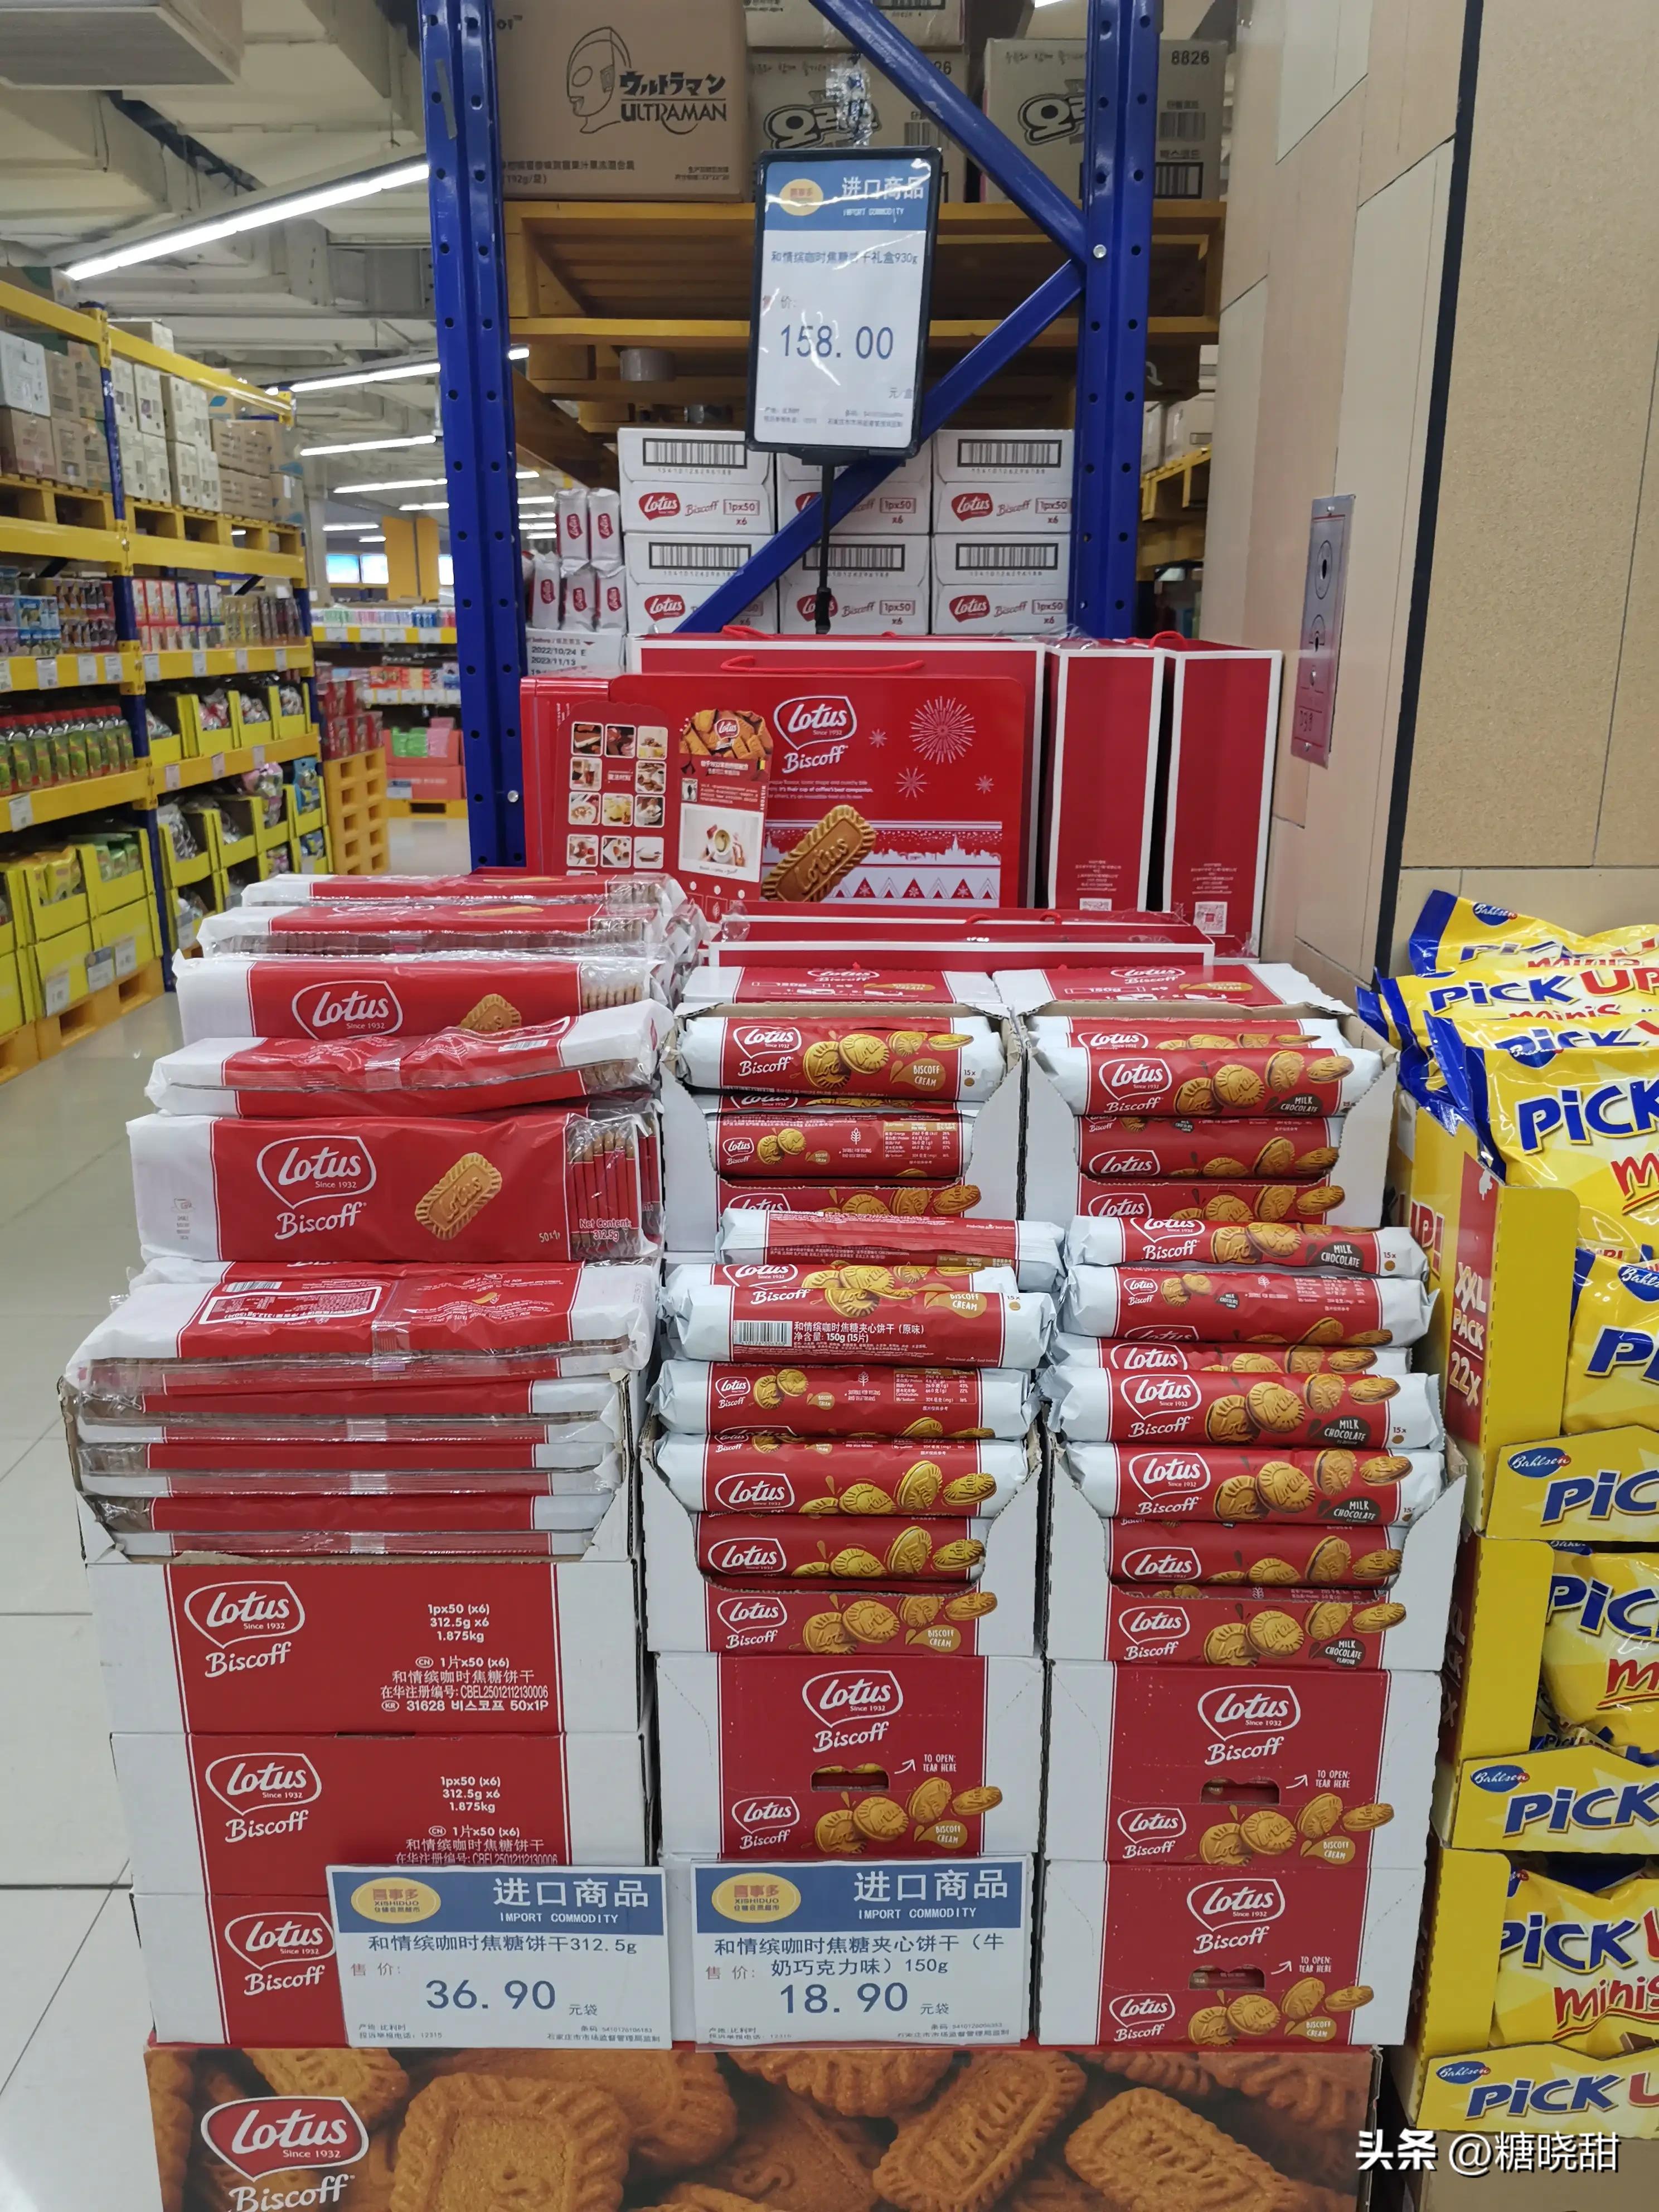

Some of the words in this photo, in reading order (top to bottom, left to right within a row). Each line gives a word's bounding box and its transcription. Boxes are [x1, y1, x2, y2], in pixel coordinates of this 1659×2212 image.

[1171, 50, 1209, 65] 8826
[620, 71, 726, 97] ウルトラマン
[620, 102, 726, 123] ULTRAMAN
[842, 176, 924, 200] 进口商品
[728, 503, 756, 512] 1px50
[884, 501, 912, 511] 1px50
[1040, 501, 1068, 511] 1px50
[884, 603, 911, 612] 1px50
[1036, 601, 1063, 612] 1px50
[788, 704, 847, 733] Lotus
[782, 745, 848, 774] Biscoff
[312, 993, 391, 1029] Lotus
[738, 1056, 794, 1076] Biscoff
[913, 1065, 940, 1075] BISCOFF
[914, 1076, 937, 1087] CREAM
[1111, 1064, 1163, 1086] Lotus
[1280, 1102, 1318, 1114] CHOCOLATE
[1294, 1096, 1313, 1105] MILK
[278, 1146, 362, 1186] Lotus
[1102, 1156, 1153, 1173] Lotus
[274, 1202, 367, 1240] Biscoff
[579, 1219, 595, 1229] Net
[593, 1229, 619, 1242] 312.5g
[1333, 1244, 1352, 1254] MILK
[1321, 1252, 1360, 1267] CHOCOLATE
[1454, 1262, 1487, 1312] XXL
[750, 1287, 812, 1304] Biscoff
[952, 1300, 977, 1311] CREAM
[794, 1322, 924, 1335] 和情缤咖时焦糖夹心饼干（原味）
[1452, 1308, 1485, 1351] PACK
[826, 1333, 845, 1343] 150g
[847, 1333, 869, 1343] (15片)
[1135, 1379, 1192, 1403] Lotus
[1128, 1416, 1194, 1438] Biscoff
[1339, 1419, 1359, 1430] MILK
[1324, 1428, 1366, 1442] CHOCOLATE
[1511, 1454, 1570, 1469] Bahlsen
[1143, 1457, 1201, 1483] Lotus
[729, 1481, 785, 1505] Lotus
[1135, 1495, 1202, 1516] Biscoff
[1348, 1501, 1370, 1511] MILK
[1333, 1508, 1376, 1521] CHOCOLATE
[722, 1545, 777, 1566] Lotus
[1134, 1553, 1192, 1577] Lotus
[207, 1592, 290, 1627] Lotus
[428, 1604, 464, 1617] 1px50
[467, 1603, 490, 1616] (x6)
[729, 1603, 779, 1622] Lotus
[266, 1622, 285, 1630] 1932
[430, 1617, 473, 1629] 312.5g
[474, 1617, 489, 1628] x6
[1131, 1613, 1182, 1634] Lotus
[437, 1631, 484, 1643] 1.875kg
[726, 1629, 778, 1649] Biscoff
[928, 1629, 954, 1638] BISCOFF
[929, 1638, 952, 1648] CREAM
[1338, 1640, 1356, 1650] MILK
[1126, 1641, 1178, 1661] Biscoff
[1325, 1647, 1362, 1660] CHOCOLATE
[205, 1641, 292, 1677] Biscoff
[487, 1656, 510, 1668] (x6)
[392, 1670, 535, 1684] 和情缤咖时焦糖饼干
[820, 1679, 891, 1709] Lotus
[406, 1700, 445, 1711] 31628
[451, 1700, 505, 1711] 비스코프
[510, 1700, 549, 1711] 50x1P
[1214, 1693, 1289, 1723] Lotus
[813, 1721, 889, 1753] Biscoff
[1204, 1736, 1284, 1765] Biscoff
[935, 1754, 956, 1763] OPEN:
[923, 1763, 938, 1773] TEAR
[940, 1763, 957, 1772] HERE
[1317, 1770, 1326, 1779] TO
[1328, 1770, 1350, 1779] OPEN:
[227, 1762, 307, 1796] Lotus
[440, 1776, 476, 1788] 1px50
[479, 1776, 501, 1788] (x6)
[1316, 1779, 1332, 1788] TEAR
[1333, 1779, 1350, 1788] HERE
[1474, 1770, 1529, 1783] Bahlsen
[443, 1789, 483, 1801] 312.5g
[485, 1789, 501, 1799] x6
[449, 1801, 496, 1813] 1.875kg
[743, 1802, 792, 1822] Lotus
[225, 1809, 309, 1843] Biscoff
[1129, 1816, 1178, 1833] Lotus
[498, 1826, 520, 1839] (x6)
[739, 1829, 790, 1850] Biscoff
[406, 1839, 544, 1852] 和情缤咖时焦糖饼干
[1122, 1840, 1176, 1859] Biscoff
[1323, 1841, 1349, 1850] BISCOFF
[493, 1878, 649, 1908] 进口商品
[853, 1869, 1008, 1903] 进口商品
[1202, 1886, 1274, 1915] Lotus
[500, 1913, 543, 1923] IMPORT
[551, 1913, 619, 1924] COMMODITY
[858, 1909, 901, 1919] IMPORT
[909, 1908, 977, 1919] COMMODITY
[245, 1919, 324, 1952] Lotus
[1193, 1925, 1270, 1954] Biscoff
[351, 1962, 366, 1977] 售
[706, 1966, 721, 1980] 售
[1299, 1964, 1314, 1973] TEAR
[1316, 1964, 1332, 1973] HERE
[244, 1965, 325, 1996] Biscoff
[425, 1979, 556, 2010] 36.90
[780, 1982, 908, 2014] 18.90
[1119, 2000, 1168, 2017] Lotus
[1306, 2020, 1331, 2029] BISCOFF
[1114, 2024, 1165, 2042] Biscoff
[1440, 2067, 1491, 2078] Bahlsen
[1464, 2074, 1625, 2121] PiCK
[231, 2108, 347, 2155] Lotus
[228, 2174, 351, 2212] Biscoff
